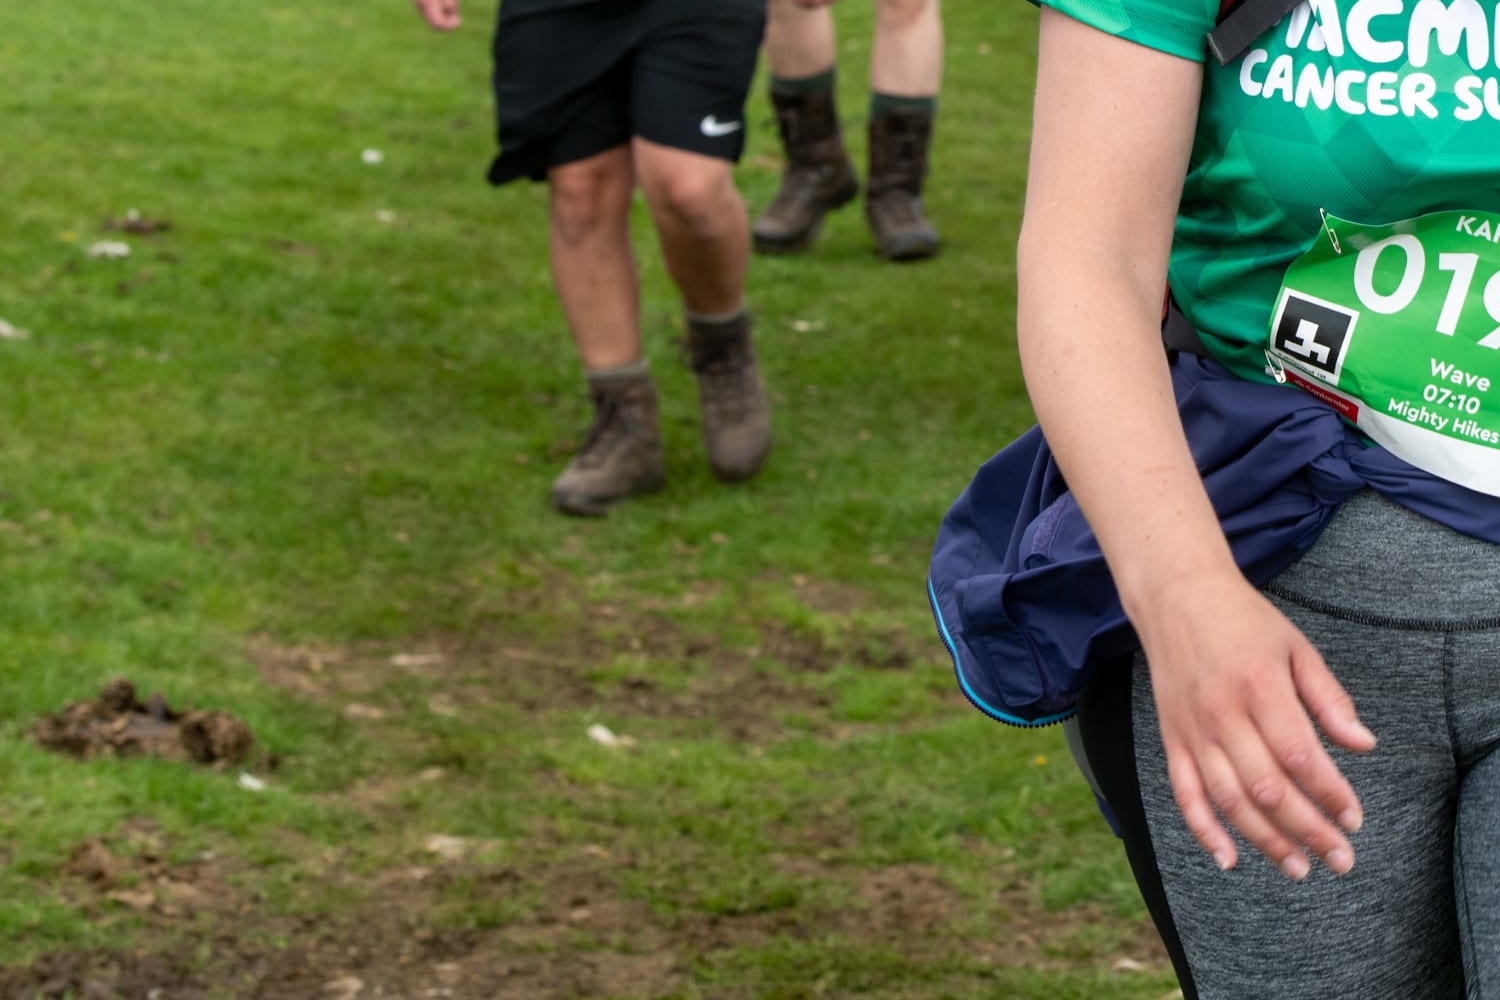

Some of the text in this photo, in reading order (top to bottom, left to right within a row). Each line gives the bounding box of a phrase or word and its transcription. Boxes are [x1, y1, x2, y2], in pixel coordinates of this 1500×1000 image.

[1239, 48, 1438, 120] CANCER
[1430, 357, 1491, 392] Wave
[1306, 383, 1350, 412] Santander
[1423, 384, 1481, 415] 07:10
[1387, 397, 1500, 444] Mighty Hikes
